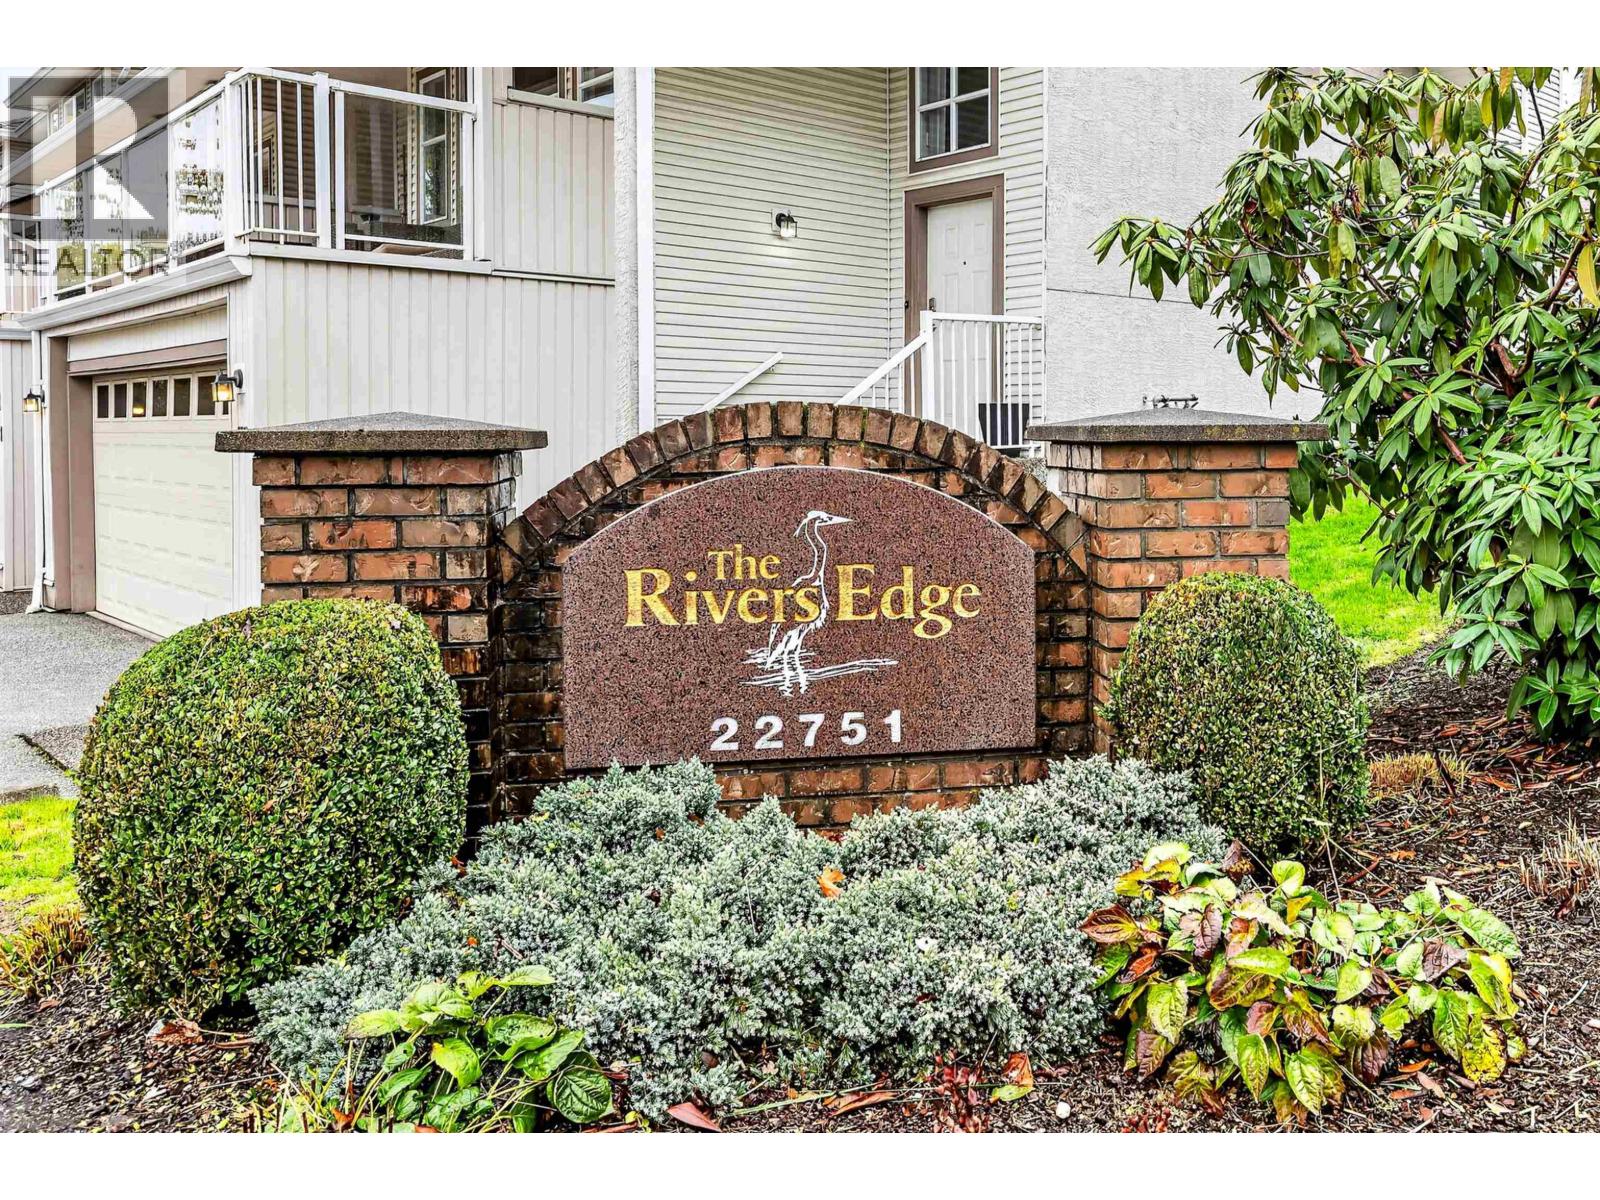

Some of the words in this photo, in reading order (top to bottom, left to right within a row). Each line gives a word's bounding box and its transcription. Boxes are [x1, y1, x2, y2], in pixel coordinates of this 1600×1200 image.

[707, 544, 781, 580] The
[623, 567, 822, 627] Rivers
[834, 563, 982, 639] Edge
[709, 709, 901, 751] 22751
